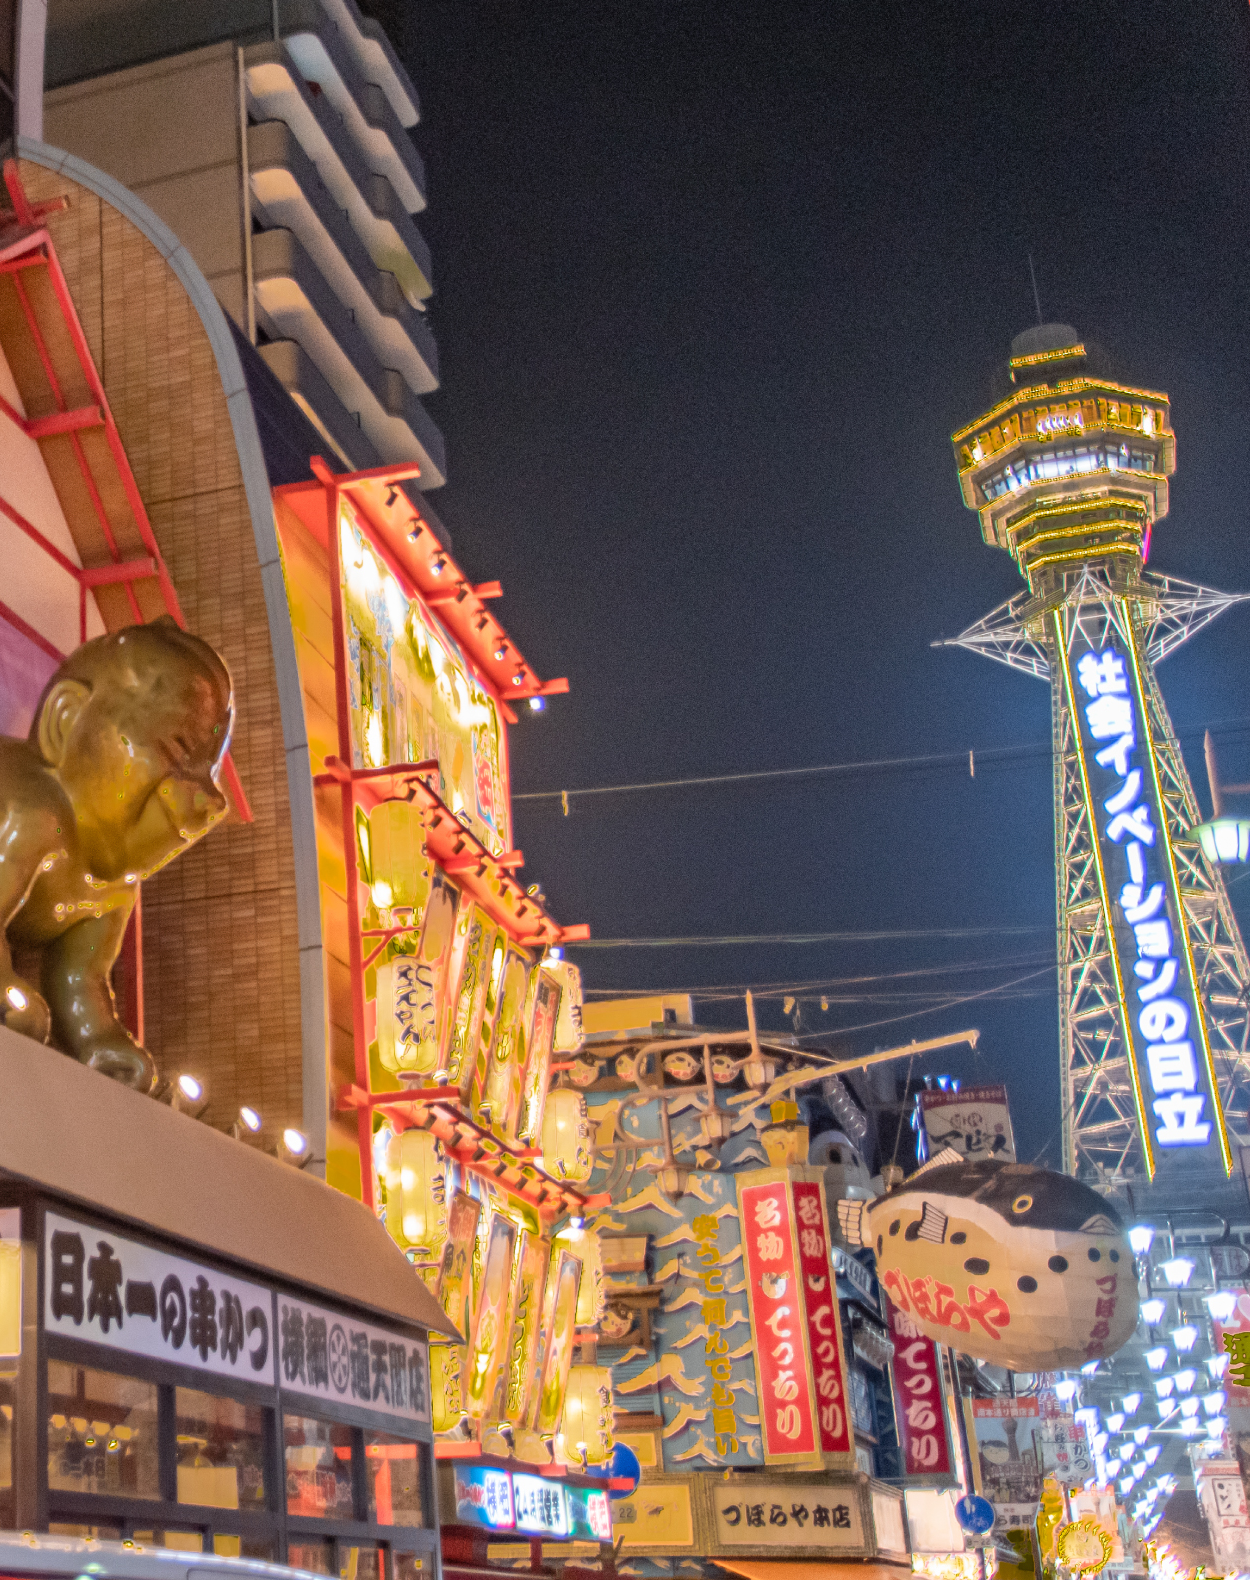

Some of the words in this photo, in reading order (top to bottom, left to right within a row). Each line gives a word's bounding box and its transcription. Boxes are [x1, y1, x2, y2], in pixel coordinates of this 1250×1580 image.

[1076, 648, 1213, 1147] 社会イノベーションの日立
[755, 1198, 783, 1261] 名物
[800, 1195, 823, 1257] 名物
[51, 1229, 268, 1371] 日本一の串かつ
[281, 1303, 328, 1391] 横綱
[350, 1329, 425, 1413] 通天閣店
[693, 1214, 738, 1455] 安うて何んでも旨い
[884, 1268, 1010, 1340] づぼらや
[765, 1306, 800, 1439] てっちり
[810, 1305, 842, 1438] てっちり
[722, 1504, 850, 1528] づぼらや本店
